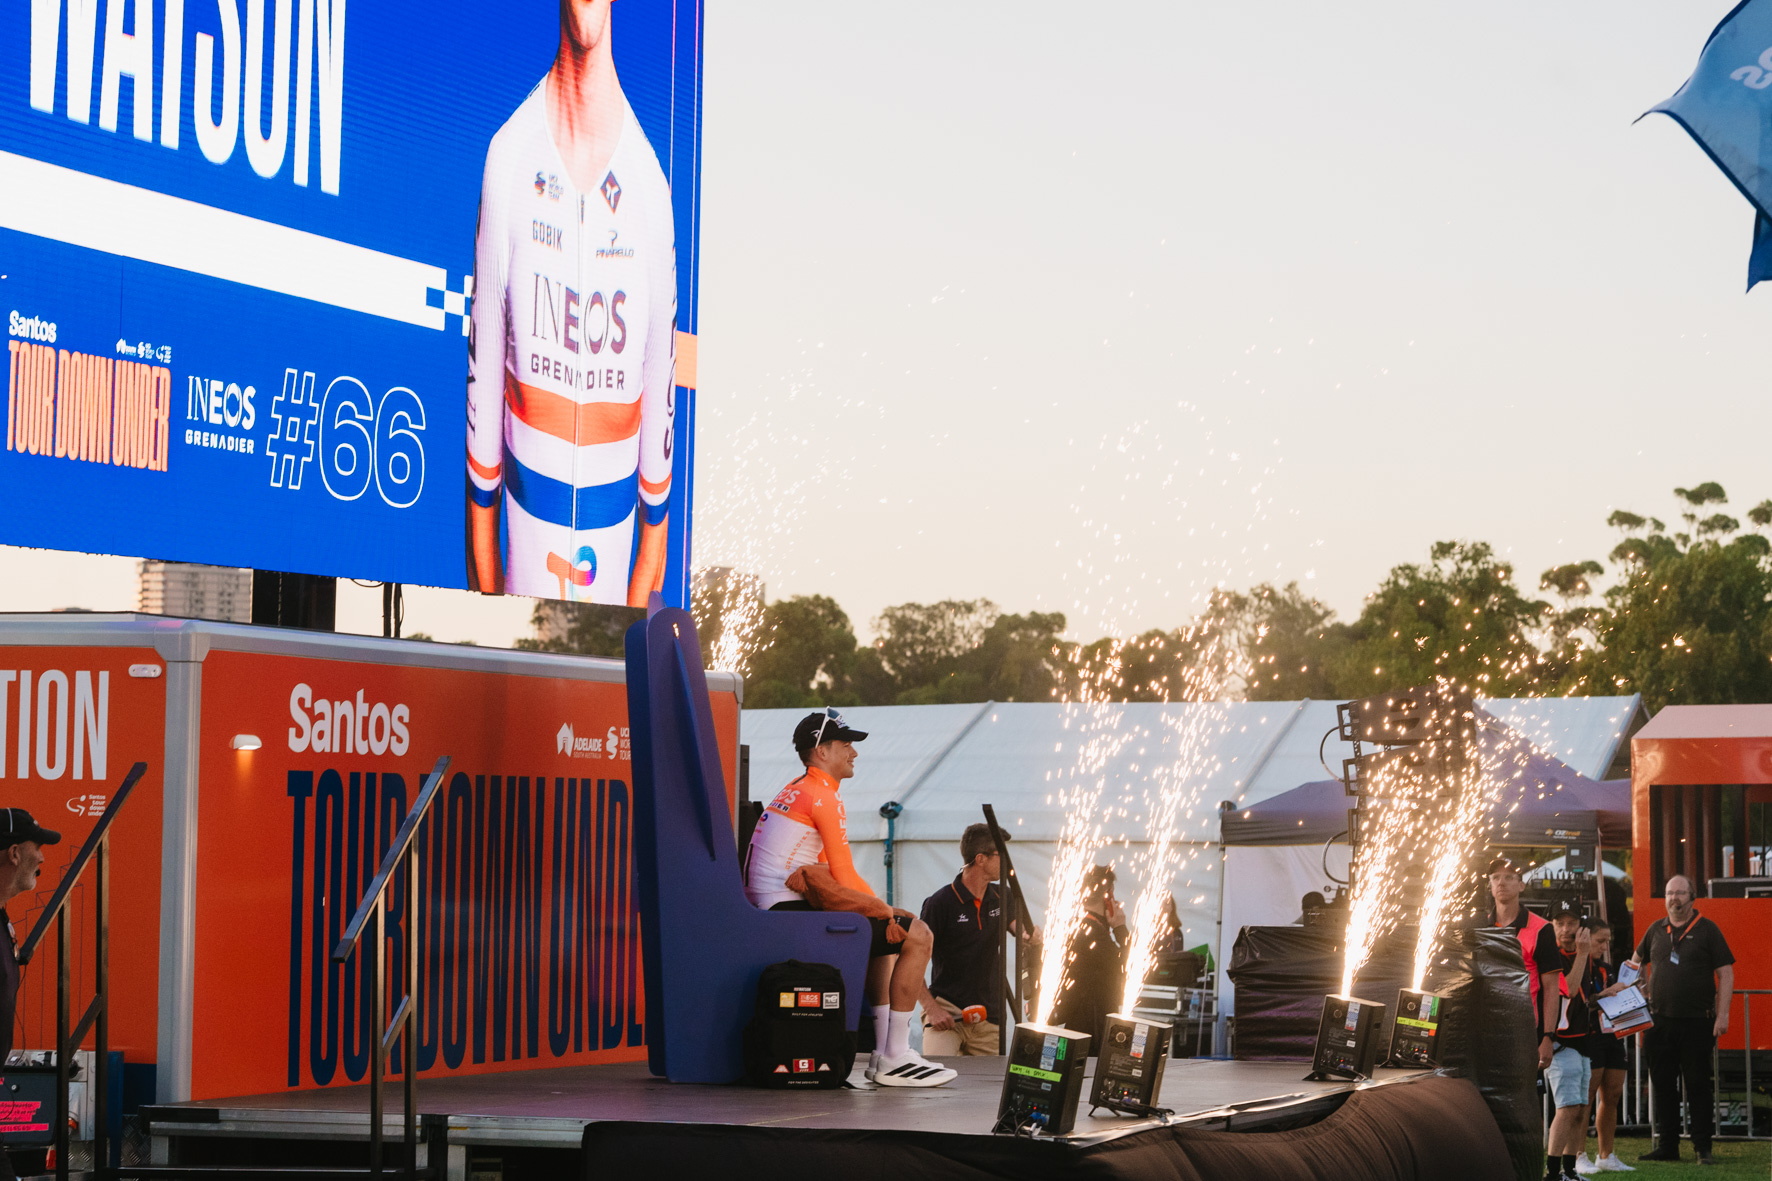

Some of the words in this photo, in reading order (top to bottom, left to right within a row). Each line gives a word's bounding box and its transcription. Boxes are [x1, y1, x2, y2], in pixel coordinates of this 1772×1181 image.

[532, 219, 563, 252] GOBIK
[595, 247, 635, 258] PINARELLO
[9, 309, 57, 344] Santos
[532, 272, 627, 355] INEOS
[531, 353, 625, 392] GRENADIER
[7, 340, 57, 457] TOUR
[55, 349, 113, 465] DOWN
[111, 359, 171, 472] UNDER
[186, 375, 256, 430] INEOS
[185, 429, 254, 454] GRENADIER
[266, 368, 426, 508] #66
[0, 669, 109, 780] TION
[288, 683, 410, 756] Santos
[575, 738, 602, 752] ADELAIDE
[287, 768, 408, 1088] TOUR
[413, 772, 546, 1072] DOWN
